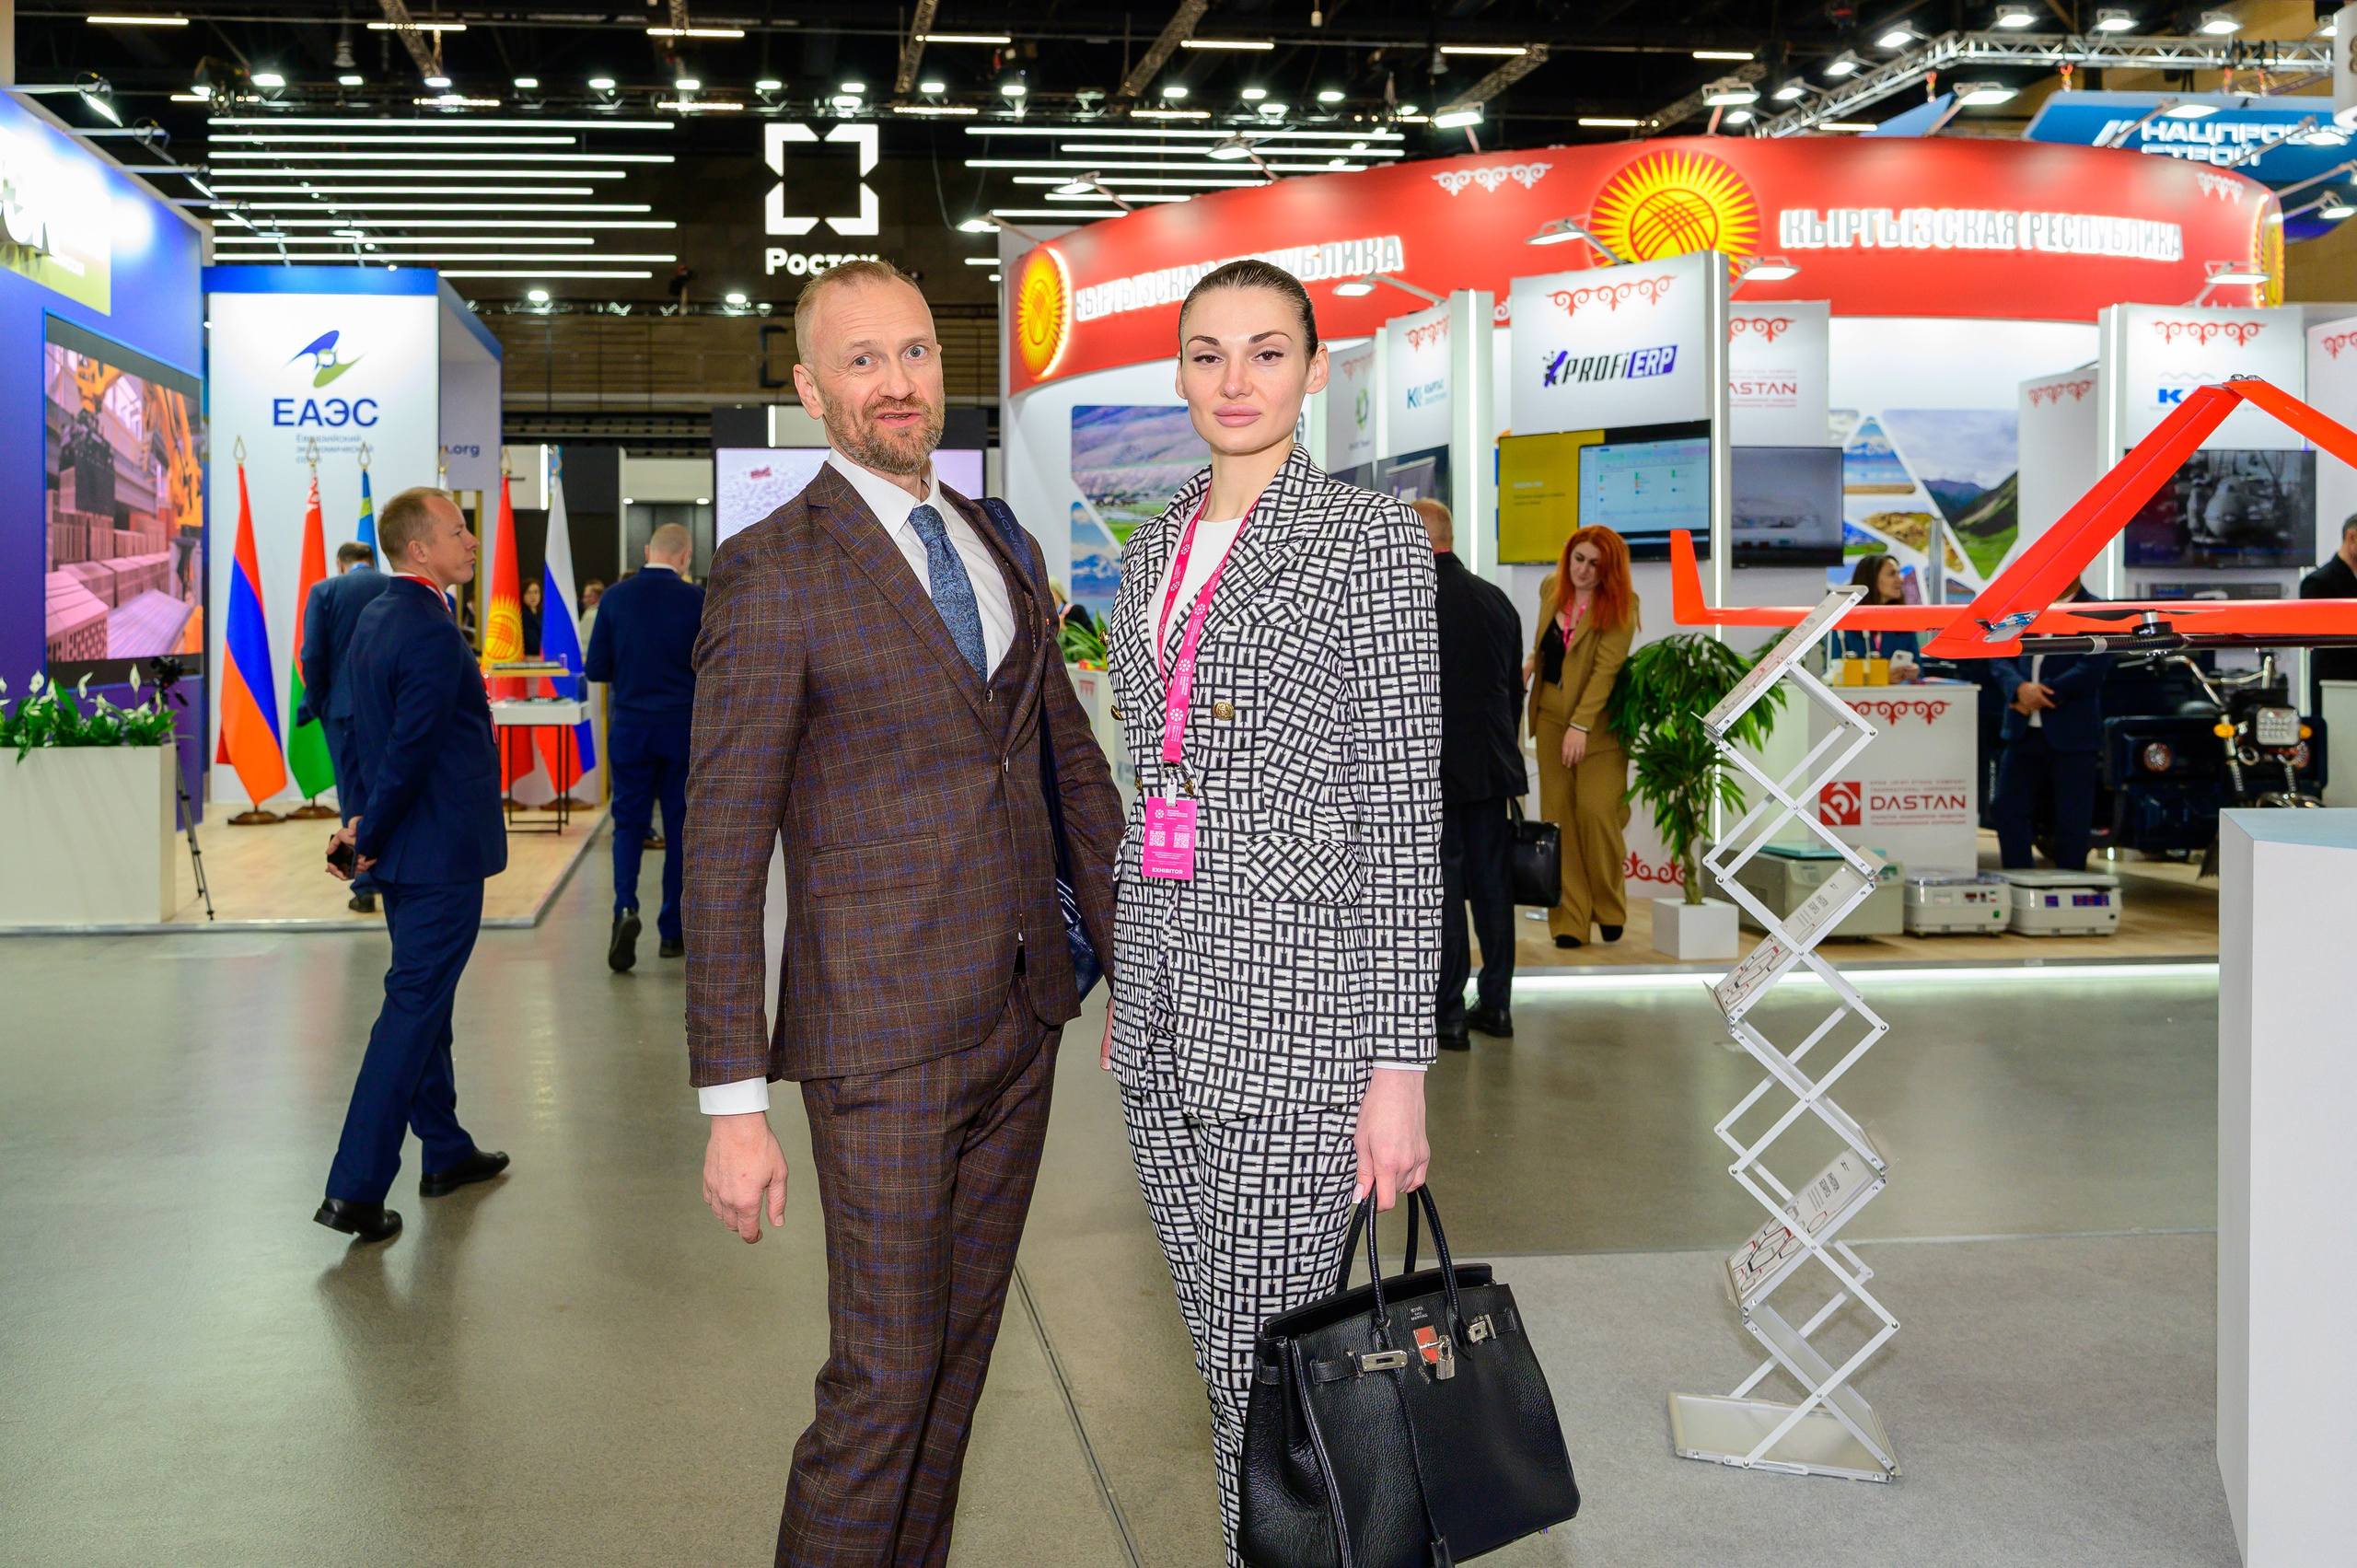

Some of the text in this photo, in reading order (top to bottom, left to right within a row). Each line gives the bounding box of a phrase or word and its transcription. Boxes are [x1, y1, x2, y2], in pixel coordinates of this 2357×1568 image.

[2142, 121, 2356, 145] НАЦПРОЕ
[1780, 208, 2184, 261] КЫРГЫЗСКАЯ РЕСПУБЛИКА
[765, 248, 879, 275] Рост
[1217, 236, 1404, 282] УБЛИКА
[1728, 381, 1796, 395] ASTAN
[273, 399, 379, 426] ЕАЭС
[1870, 795, 1967, 810] DASTAN
